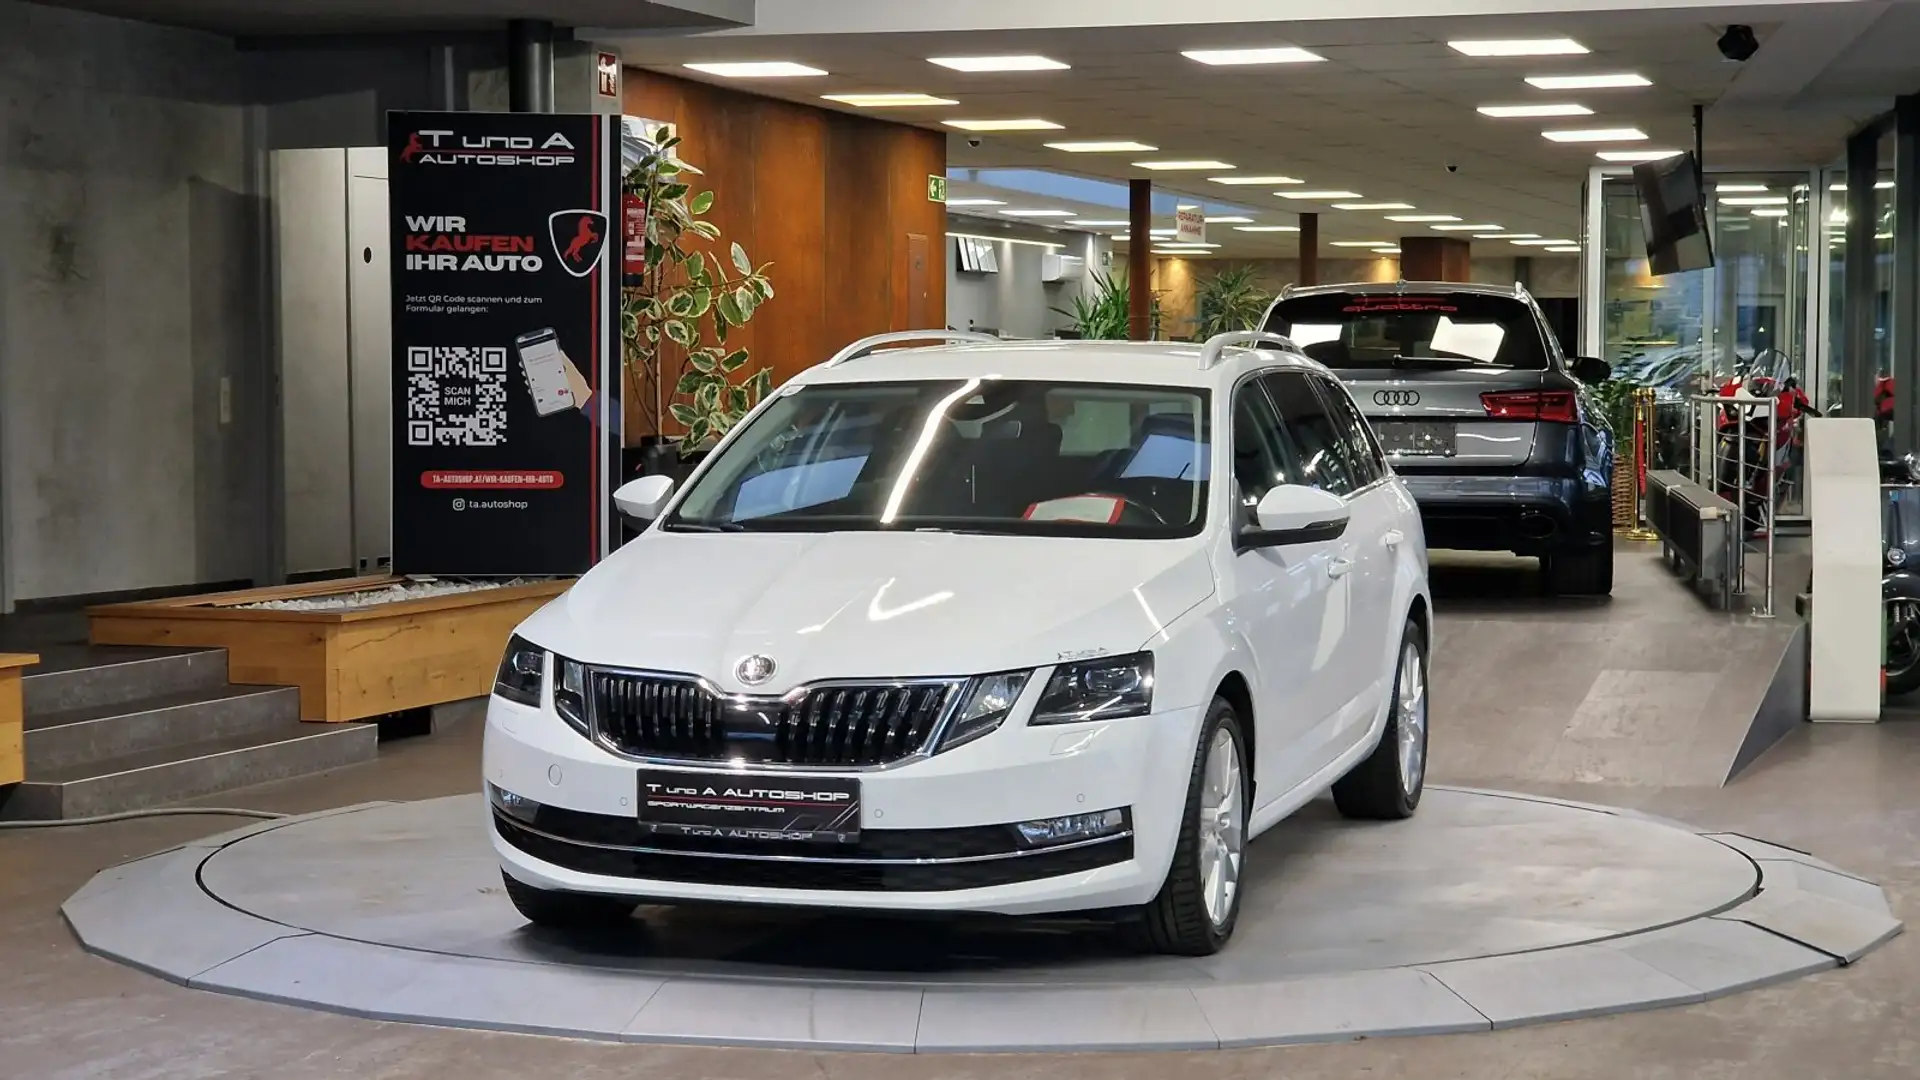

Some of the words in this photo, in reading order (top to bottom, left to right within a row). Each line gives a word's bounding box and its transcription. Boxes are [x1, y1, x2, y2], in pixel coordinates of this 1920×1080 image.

[418, 130, 454, 148] T
[540, 132, 575, 149] A
[418, 154, 575, 166] AUTOSHOP
[405, 216, 466, 232] WIR
[405, 235, 534, 252] KAUFEN
[406, 255, 459, 271] IHR
[461, 255, 543, 272] AUTO
[405, 295, 426, 303] Jetzt
[428, 295, 442, 304] QR
[443, 295, 465, 303] Code
[504, 296, 522, 304] und
[405, 304, 444, 312] Formular
[446, 305, 489, 314] gelangen:
[1342, 303, 1458, 313] quattro
[444, 387, 471, 396] SCAN
[444, 397, 471, 406] MICH
[469, 500, 528, 510] ta.autoshop
[646, 783, 662, 793] T
[703, 787, 717, 796] A
[723, 788, 850, 801] AUTOSHOP
[681, 827, 692, 835] T
[728, 830, 813, 840] AUTOSHOP
